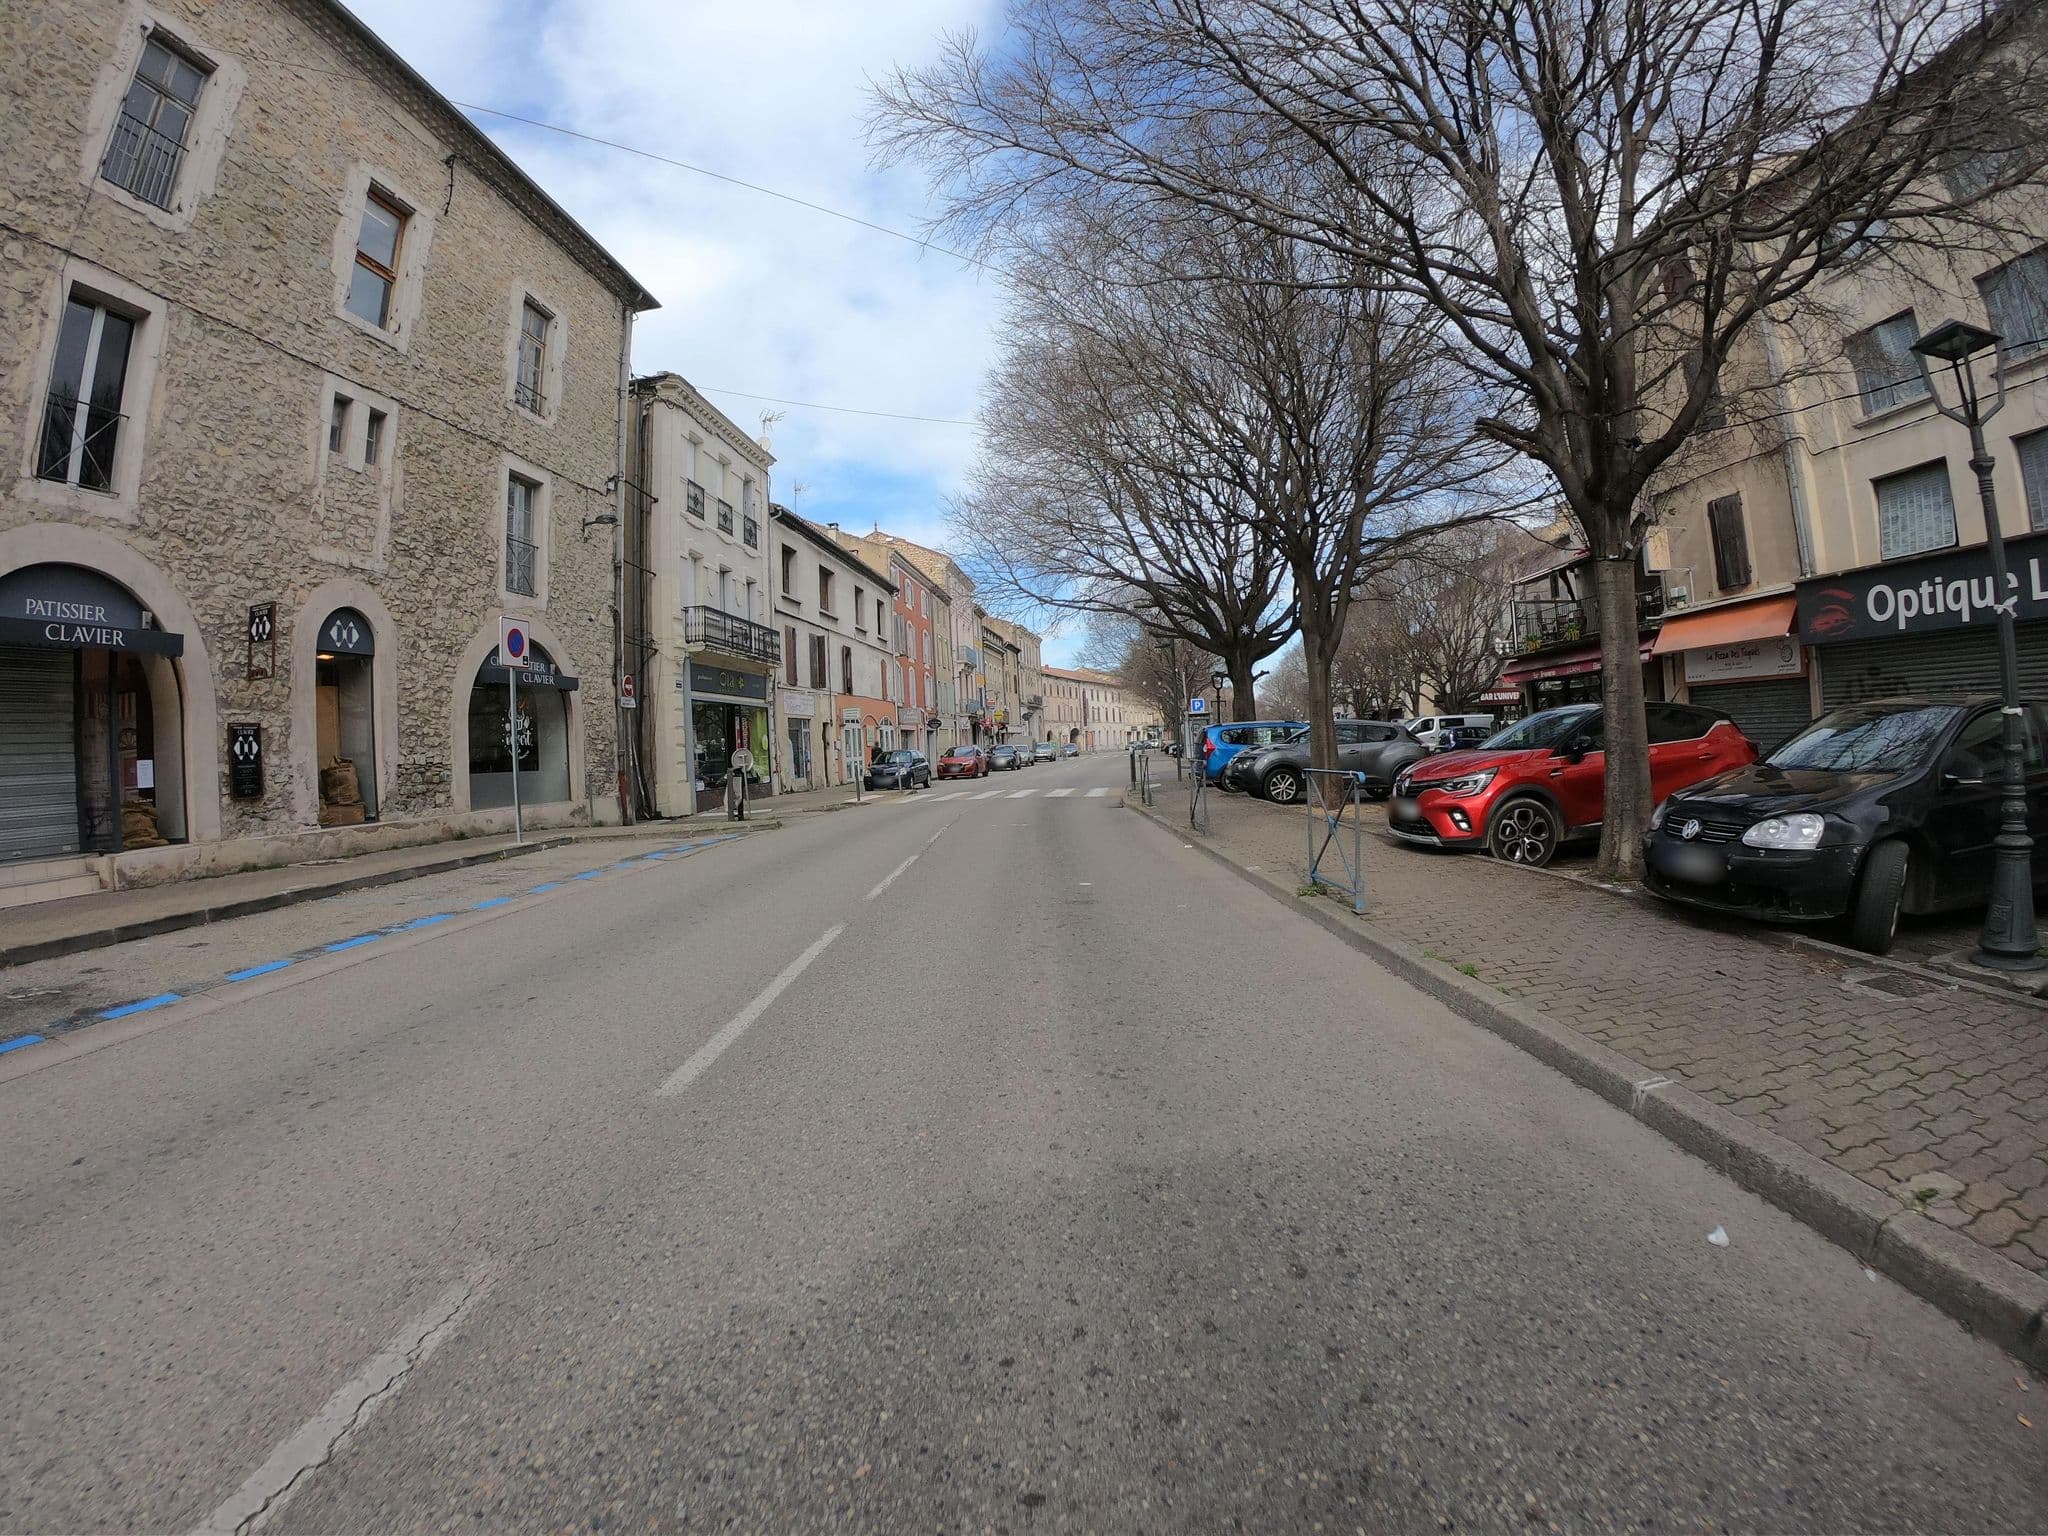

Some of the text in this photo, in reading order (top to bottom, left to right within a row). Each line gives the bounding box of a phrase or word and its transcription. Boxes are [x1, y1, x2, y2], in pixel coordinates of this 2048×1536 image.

[25, 598, 108, 622] PATISSIER
[1867, 573, 2018, 629] Optiqu
[45, 623, 126, 646] CLAVIER
[522, 672, 555, 685] CLAVIER
